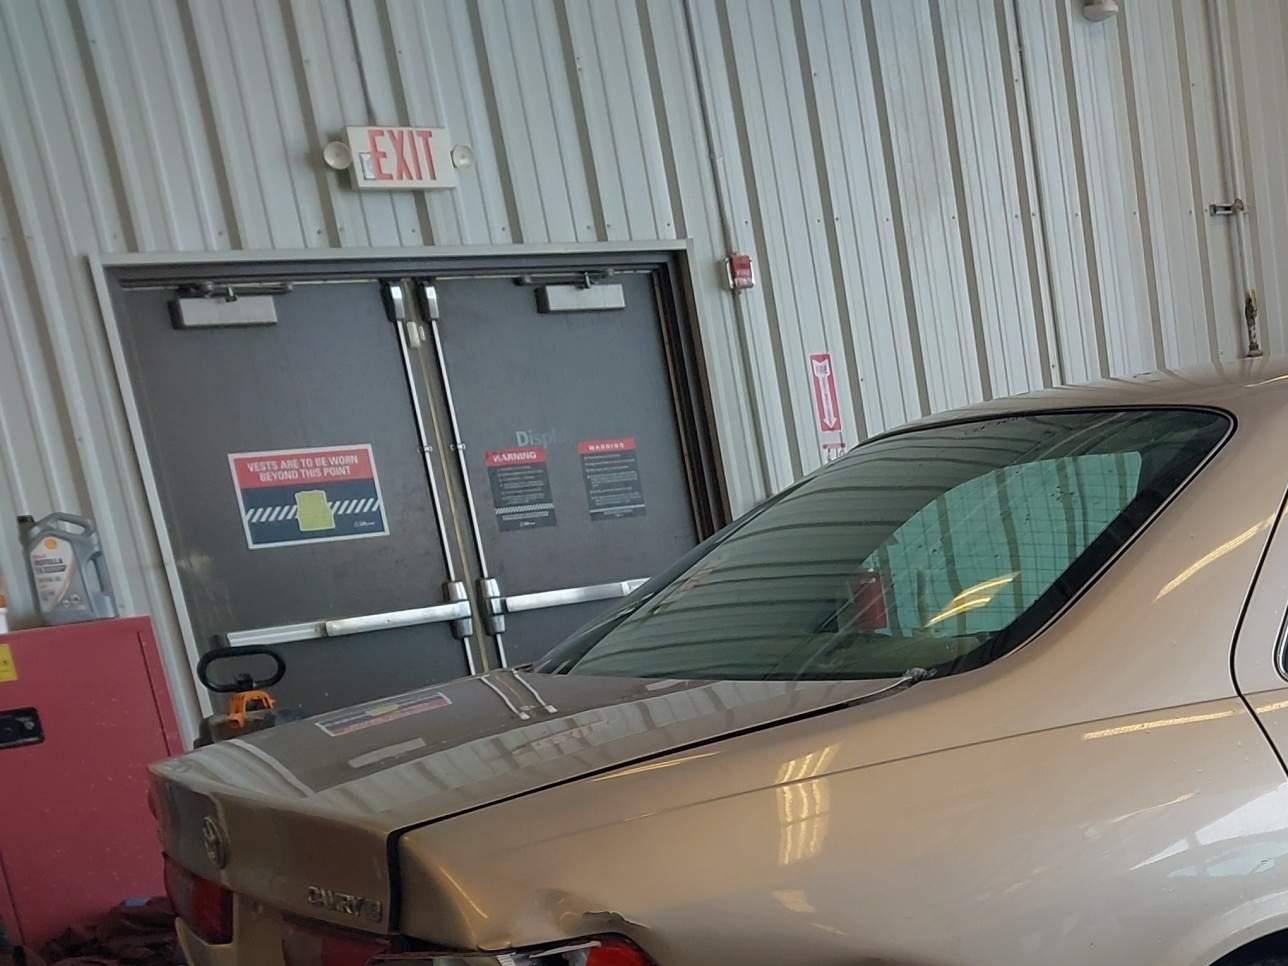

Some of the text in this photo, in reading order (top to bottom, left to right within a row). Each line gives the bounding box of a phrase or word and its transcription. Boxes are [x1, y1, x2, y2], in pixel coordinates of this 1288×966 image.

[368, 129, 437, 180] EXIT
[588, 442, 625, 452] WARNING
[247, 455, 359, 473] VESTS ARE TO BE WORN
[492, 451, 537, 463] WARNING
[259, 465, 351, 482] BEYOND THIS POINT
